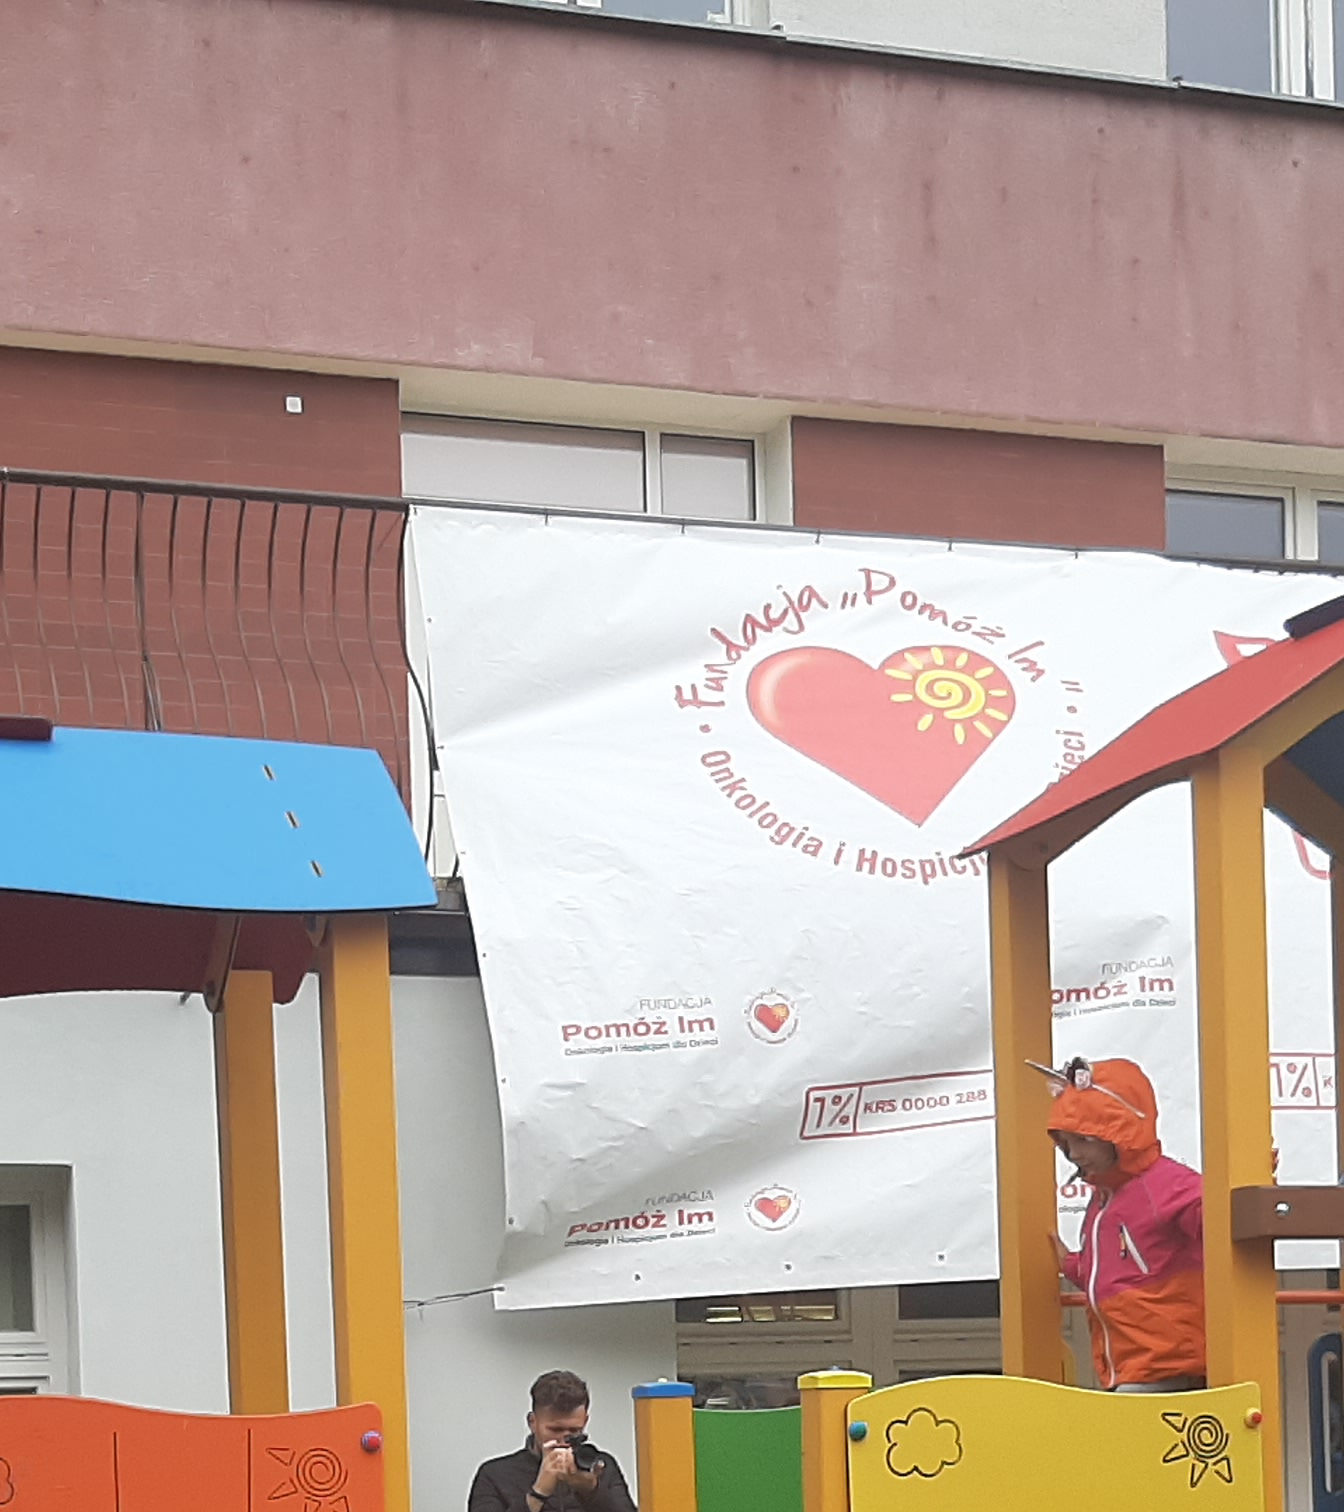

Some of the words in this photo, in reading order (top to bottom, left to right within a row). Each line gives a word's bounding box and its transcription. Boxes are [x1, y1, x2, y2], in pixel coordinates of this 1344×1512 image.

[674, 584, 830, 709] Fundacja
[700, 750, 824, 858] Onkologia
[833, 841, 846, 866] i
[639, 997, 713, 1012] FUNDACJA
[1051, 980, 1128, 1005] omóż
[1138, 975, 1174, 993] Im
[561, 1016, 669, 1042] Pomóż
[678, 1015, 716, 1034] Im
[813, 1092, 854, 1130] 1%
[863, 1099, 897, 1114] KRS
[902, 1095, 950, 1111] 0000
[567, 1209, 667, 1237] Pomóż
[677, 1209, 714, 1226] Im
